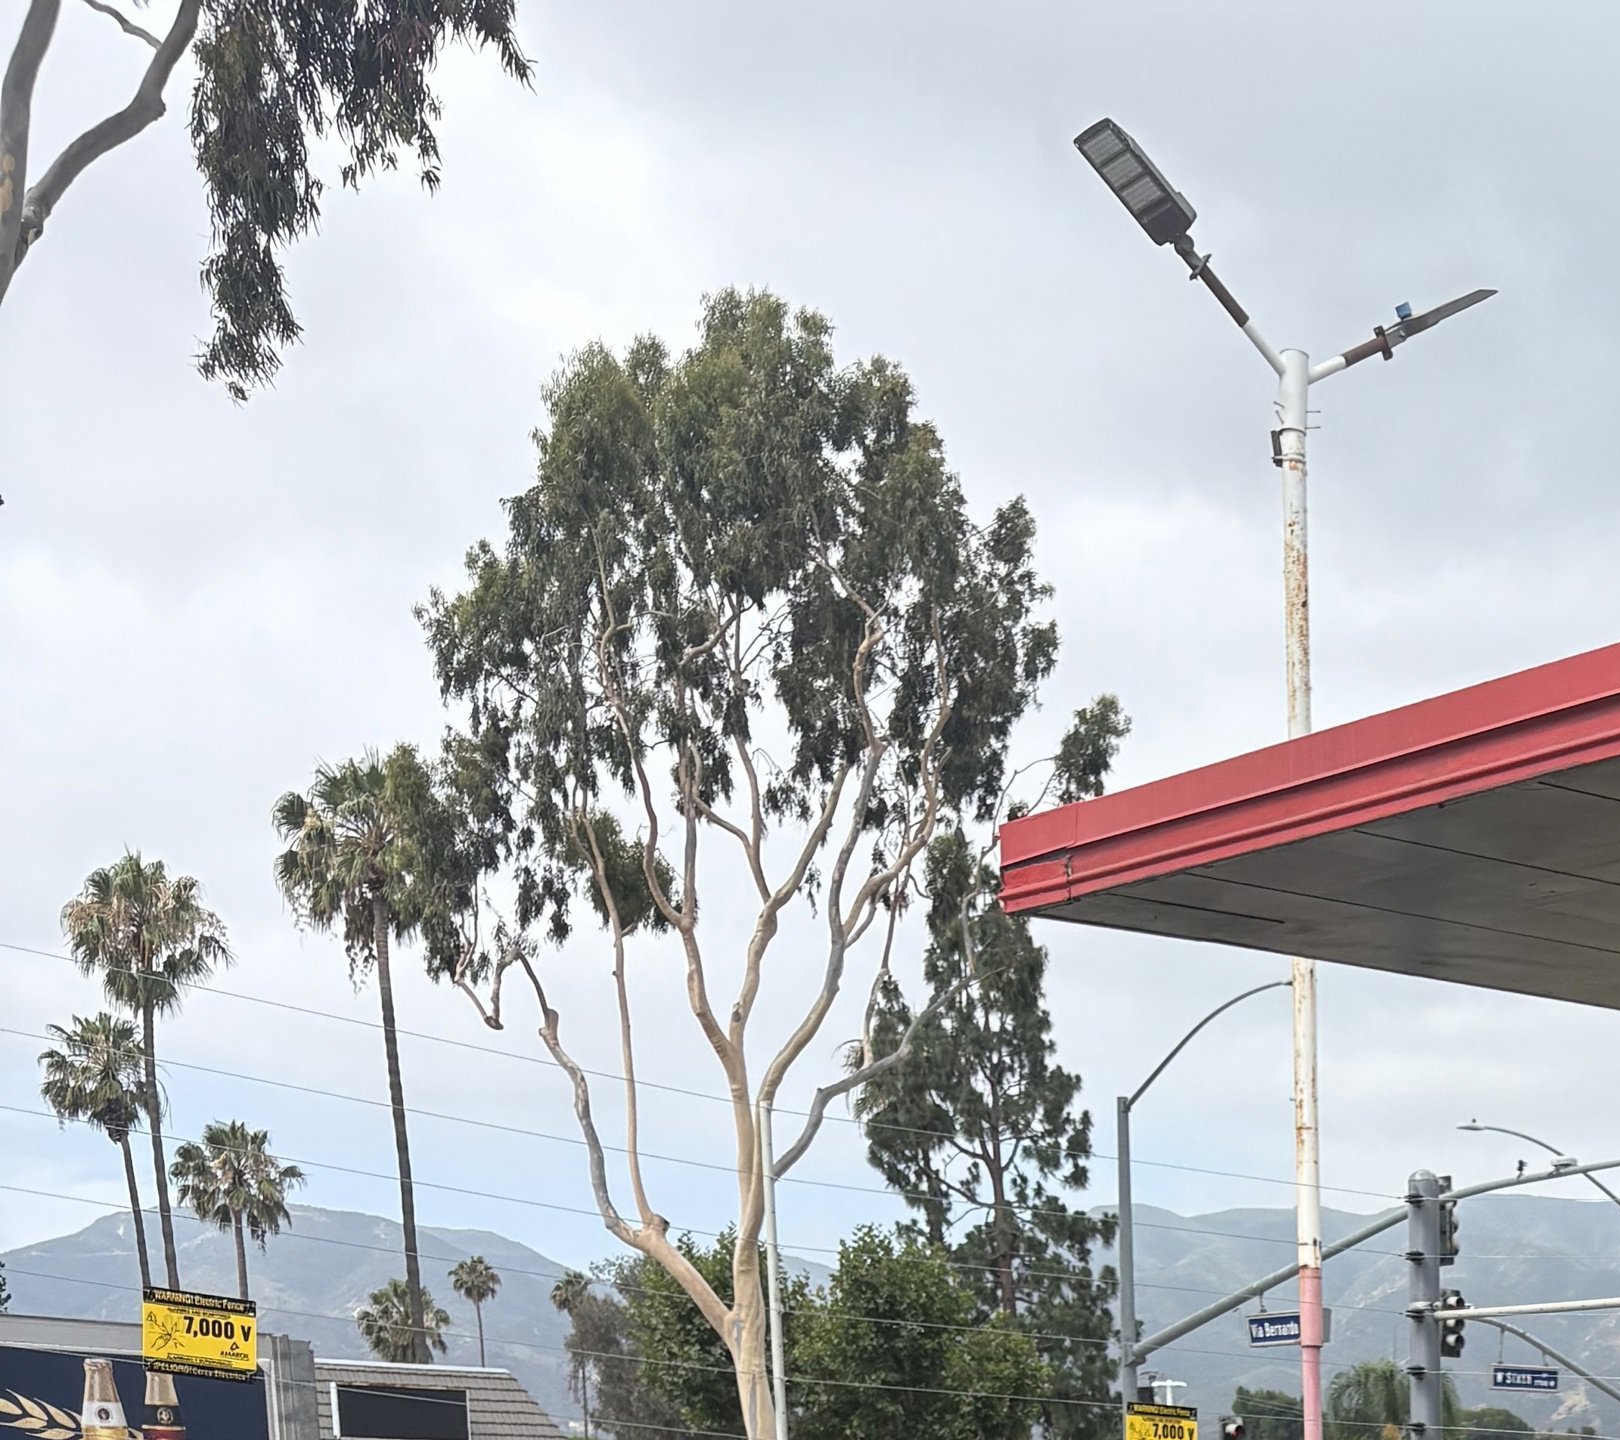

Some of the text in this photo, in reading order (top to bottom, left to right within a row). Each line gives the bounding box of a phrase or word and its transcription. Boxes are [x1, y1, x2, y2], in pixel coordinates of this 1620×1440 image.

[183, 1315, 252, 1343] 7,000 V
[1152, 1423, 1184, 1440] 7,000
